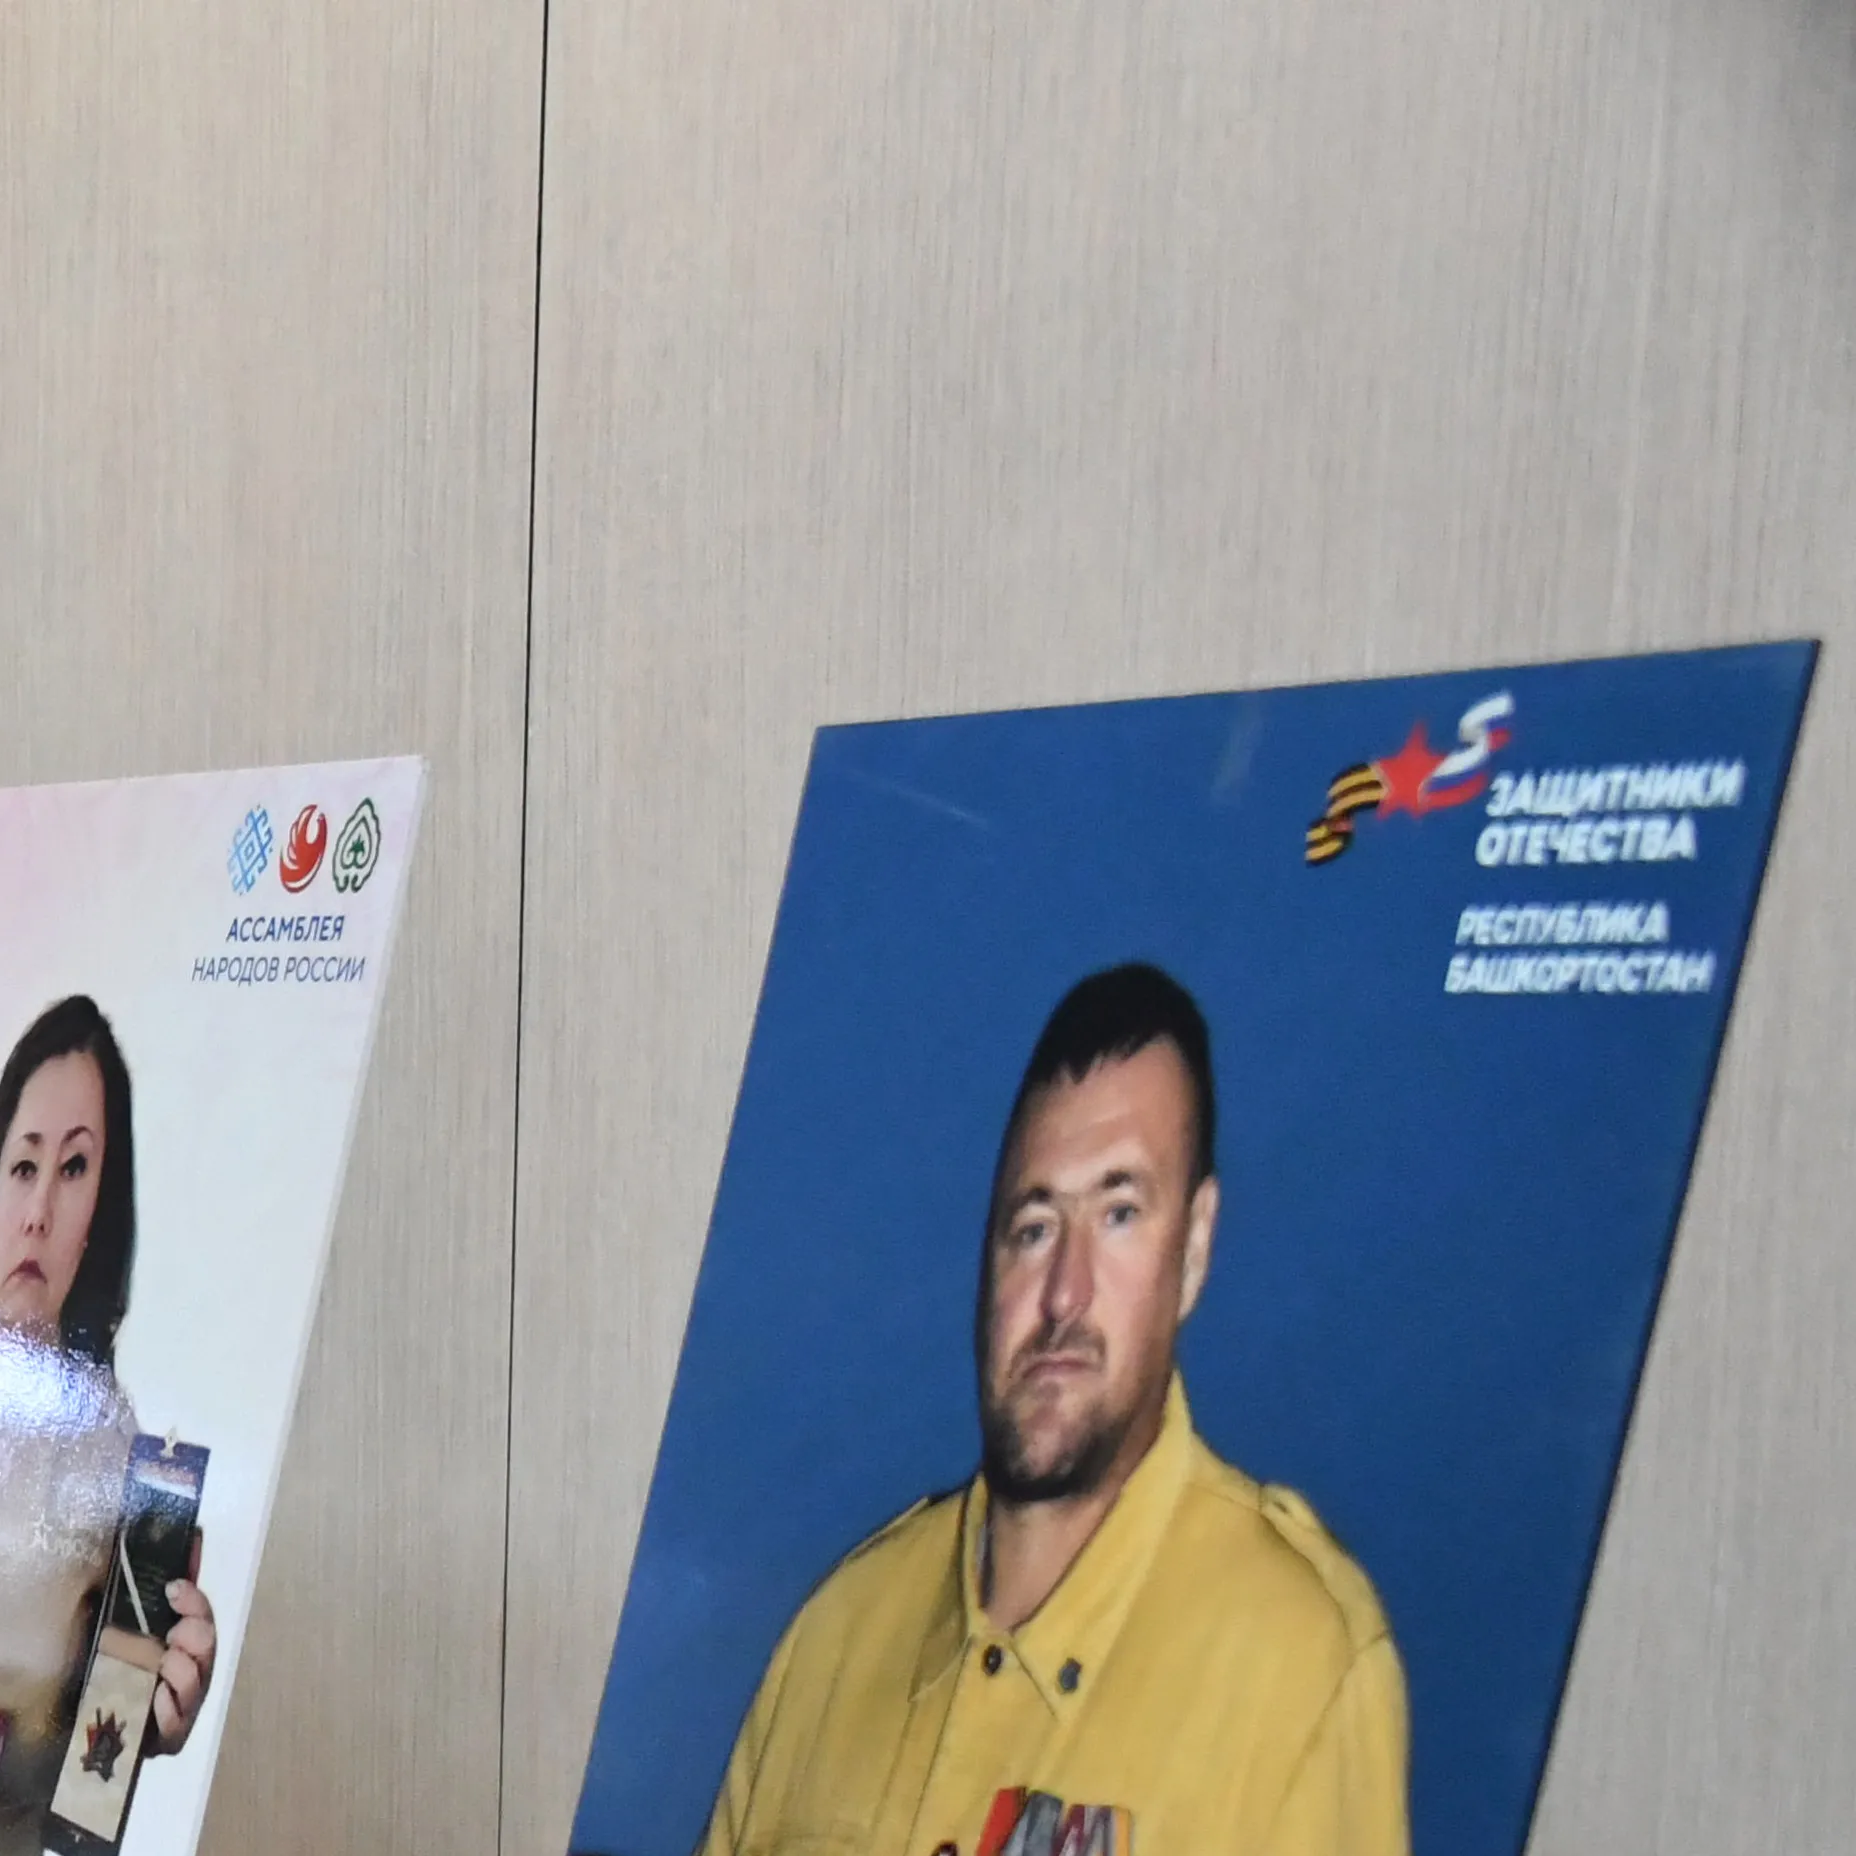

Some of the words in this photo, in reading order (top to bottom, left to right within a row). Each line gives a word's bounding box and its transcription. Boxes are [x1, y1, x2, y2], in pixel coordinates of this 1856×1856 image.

[1485, 758, 1746, 818] ЗАЩИТНИКИ
[1475, 814, 1697, 868] ОТЕЧЕСТВА
[225, 915, 345, 943] АССАМБЛЕЯ
[1455, 901, 1670, 946] РЕСПУБЛИКА
[191, 956, 280, 986] НАРОДОВ
[283, 956, 366, 983] РОССИИ
[1444, 949, 1716, 994] БАШКОРТОСТАН
